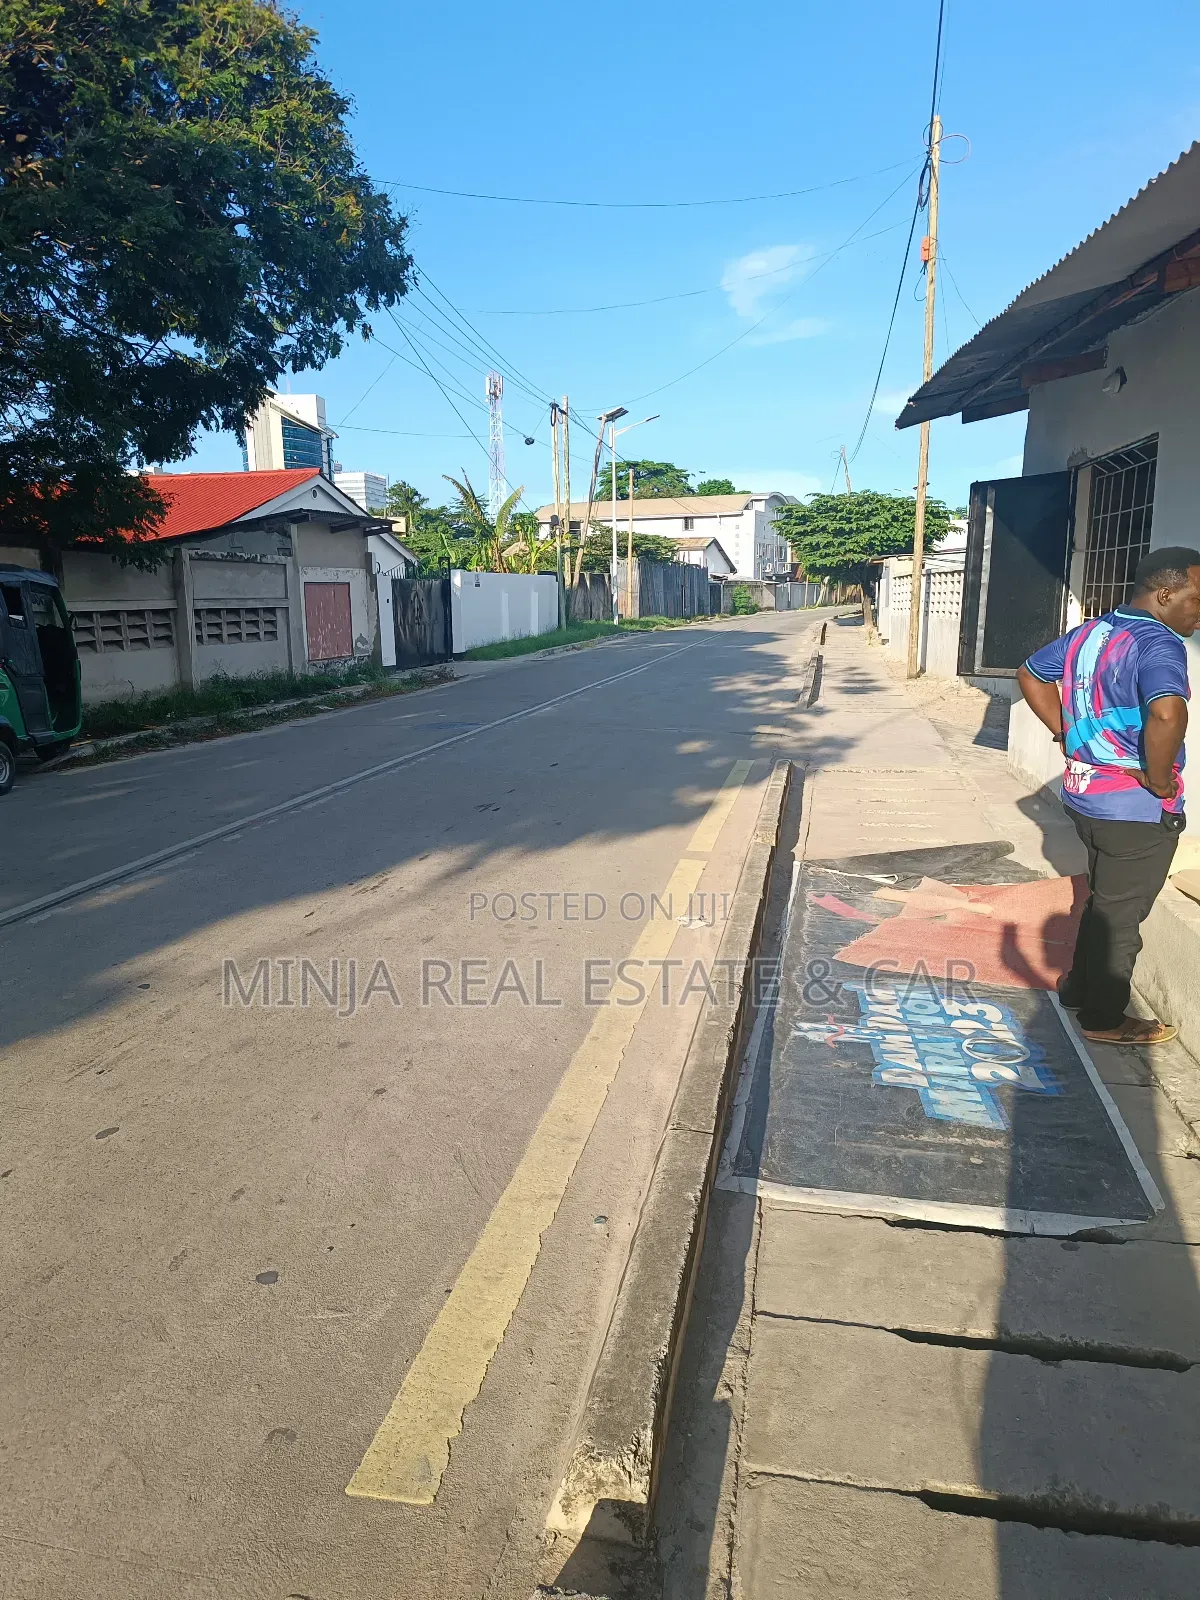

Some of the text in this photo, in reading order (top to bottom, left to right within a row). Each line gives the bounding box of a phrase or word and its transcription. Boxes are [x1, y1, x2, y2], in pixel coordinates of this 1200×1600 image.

[880, 1034, 929, 1087] DAM
[896, 983, 993, 1124] MARATHON
[940, 998, 1046, 1089] 2023
